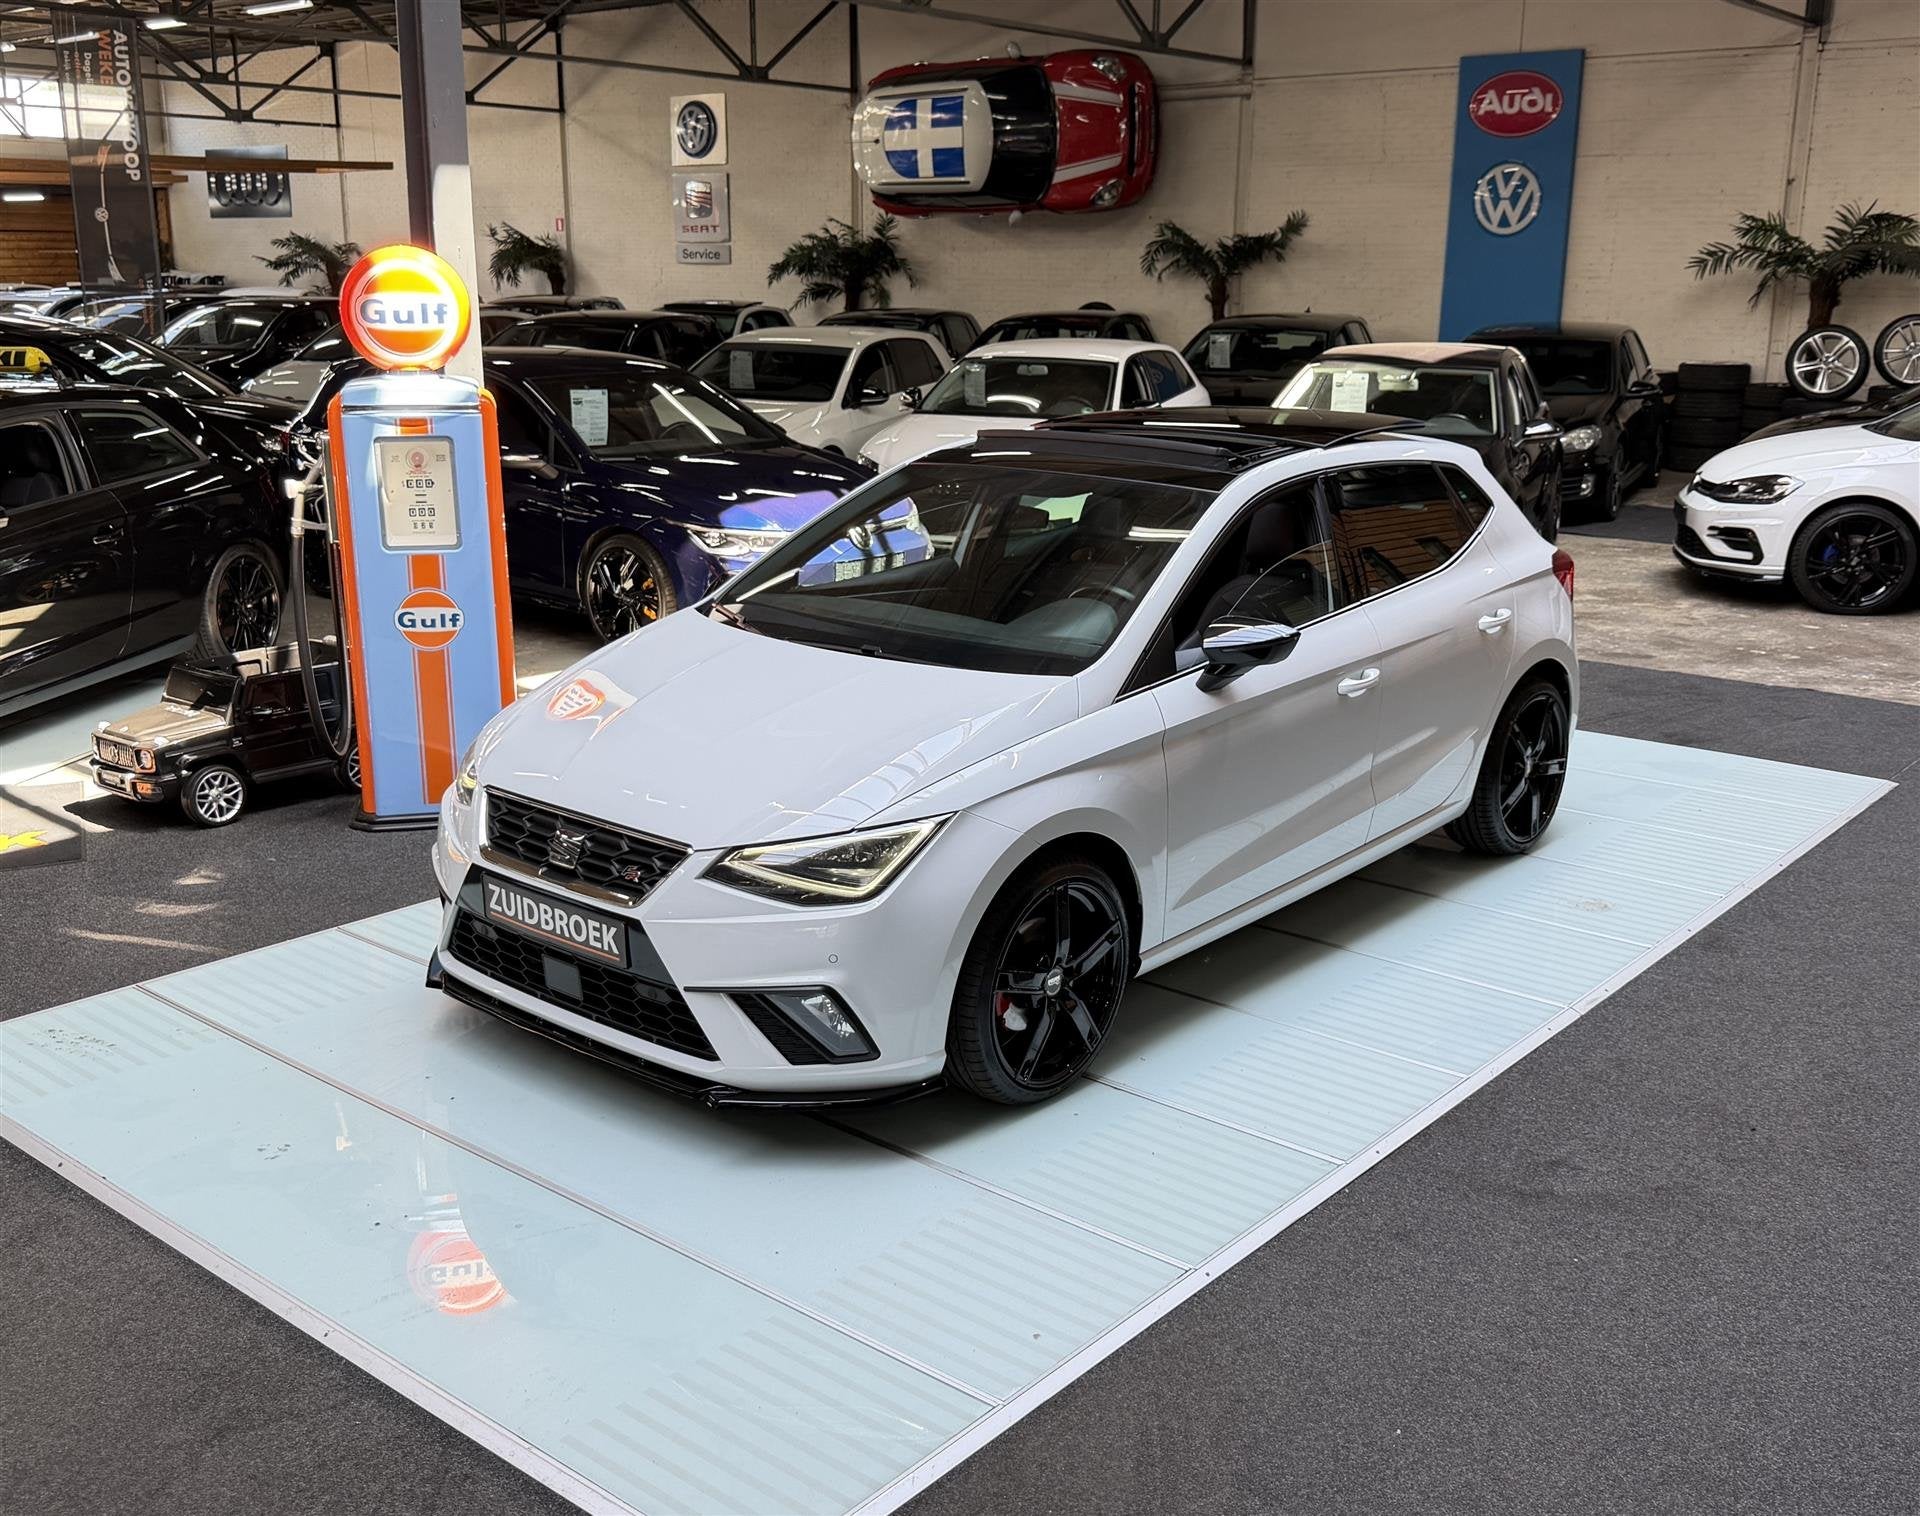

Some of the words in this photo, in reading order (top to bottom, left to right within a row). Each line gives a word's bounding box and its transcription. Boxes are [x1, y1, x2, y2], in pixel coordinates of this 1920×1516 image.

[681, 225, 720, 233] SEAT
[682, 248, 721, 260] Service
[360, 298, 448, 324] Gulf
[397, 611, 461, 629] Gulf
[488, 883, 620, 955] ZUIDBROEK
